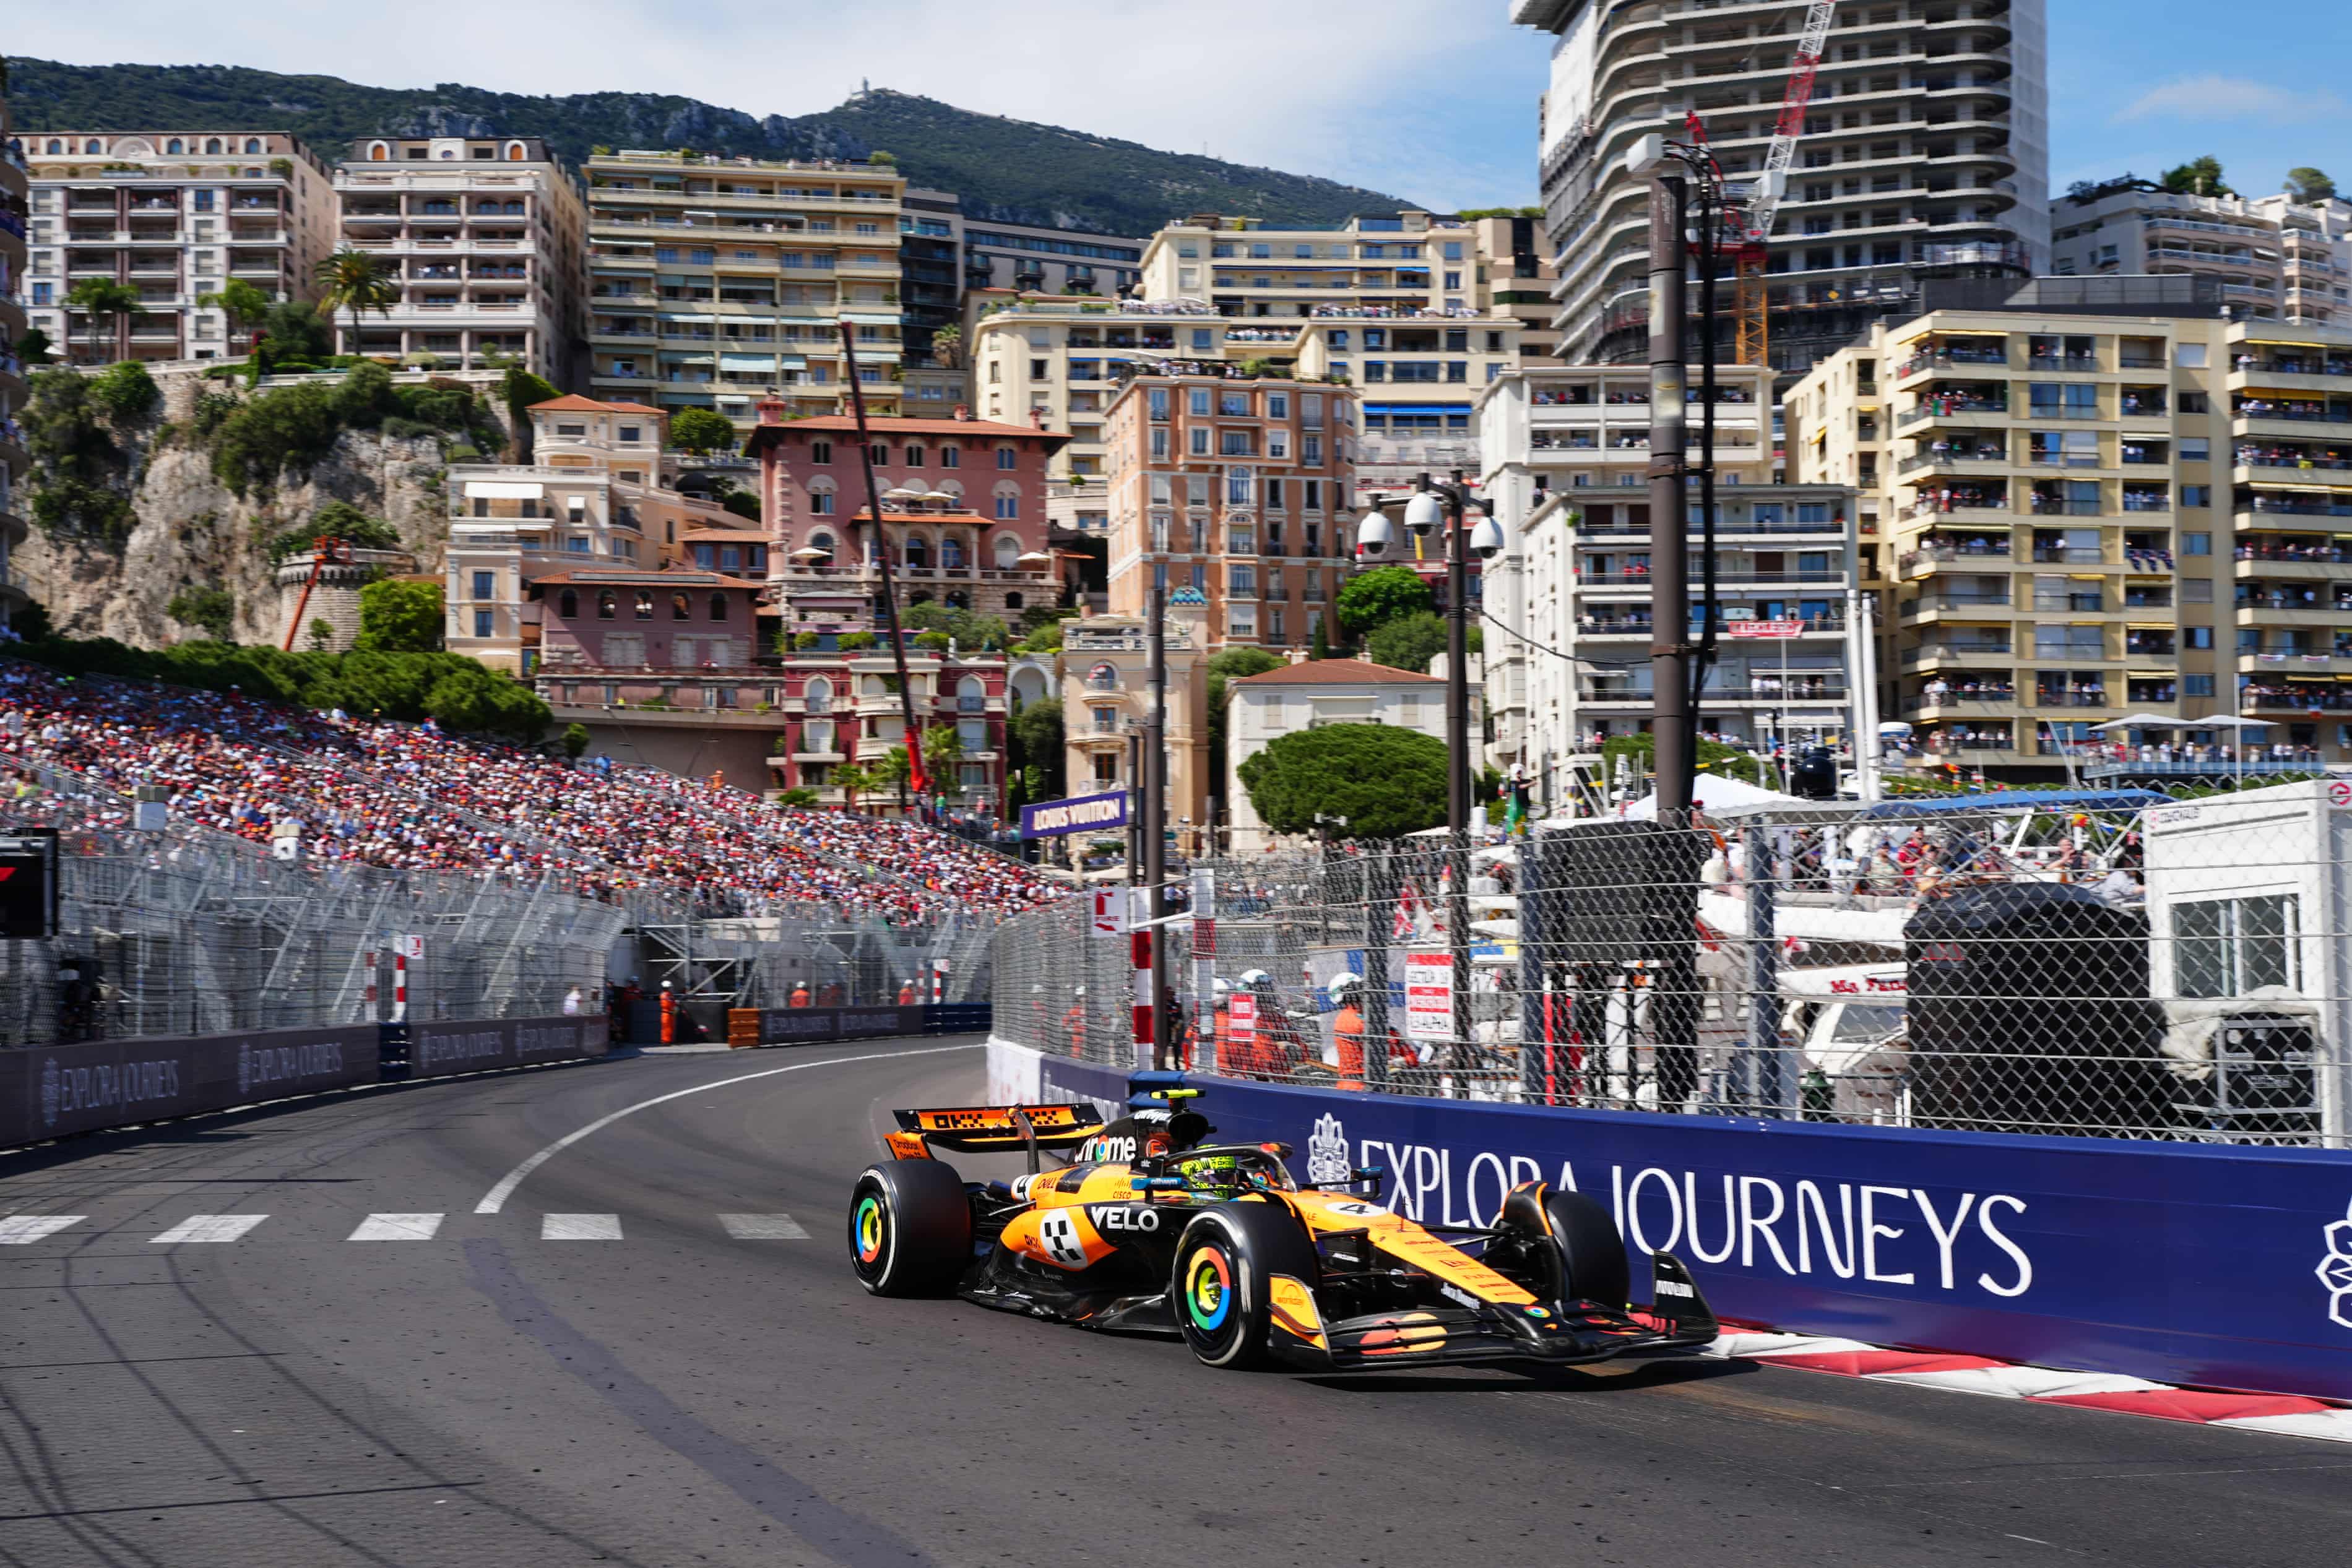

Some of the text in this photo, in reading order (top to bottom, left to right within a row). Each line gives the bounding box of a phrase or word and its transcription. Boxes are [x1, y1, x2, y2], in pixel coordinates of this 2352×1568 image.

[1034, 798, 1120, 831] LOUIS VUITTON
[1091, 1207, 1159, 1232] VELO
[1338, 1204, 1370, 1215] 4
